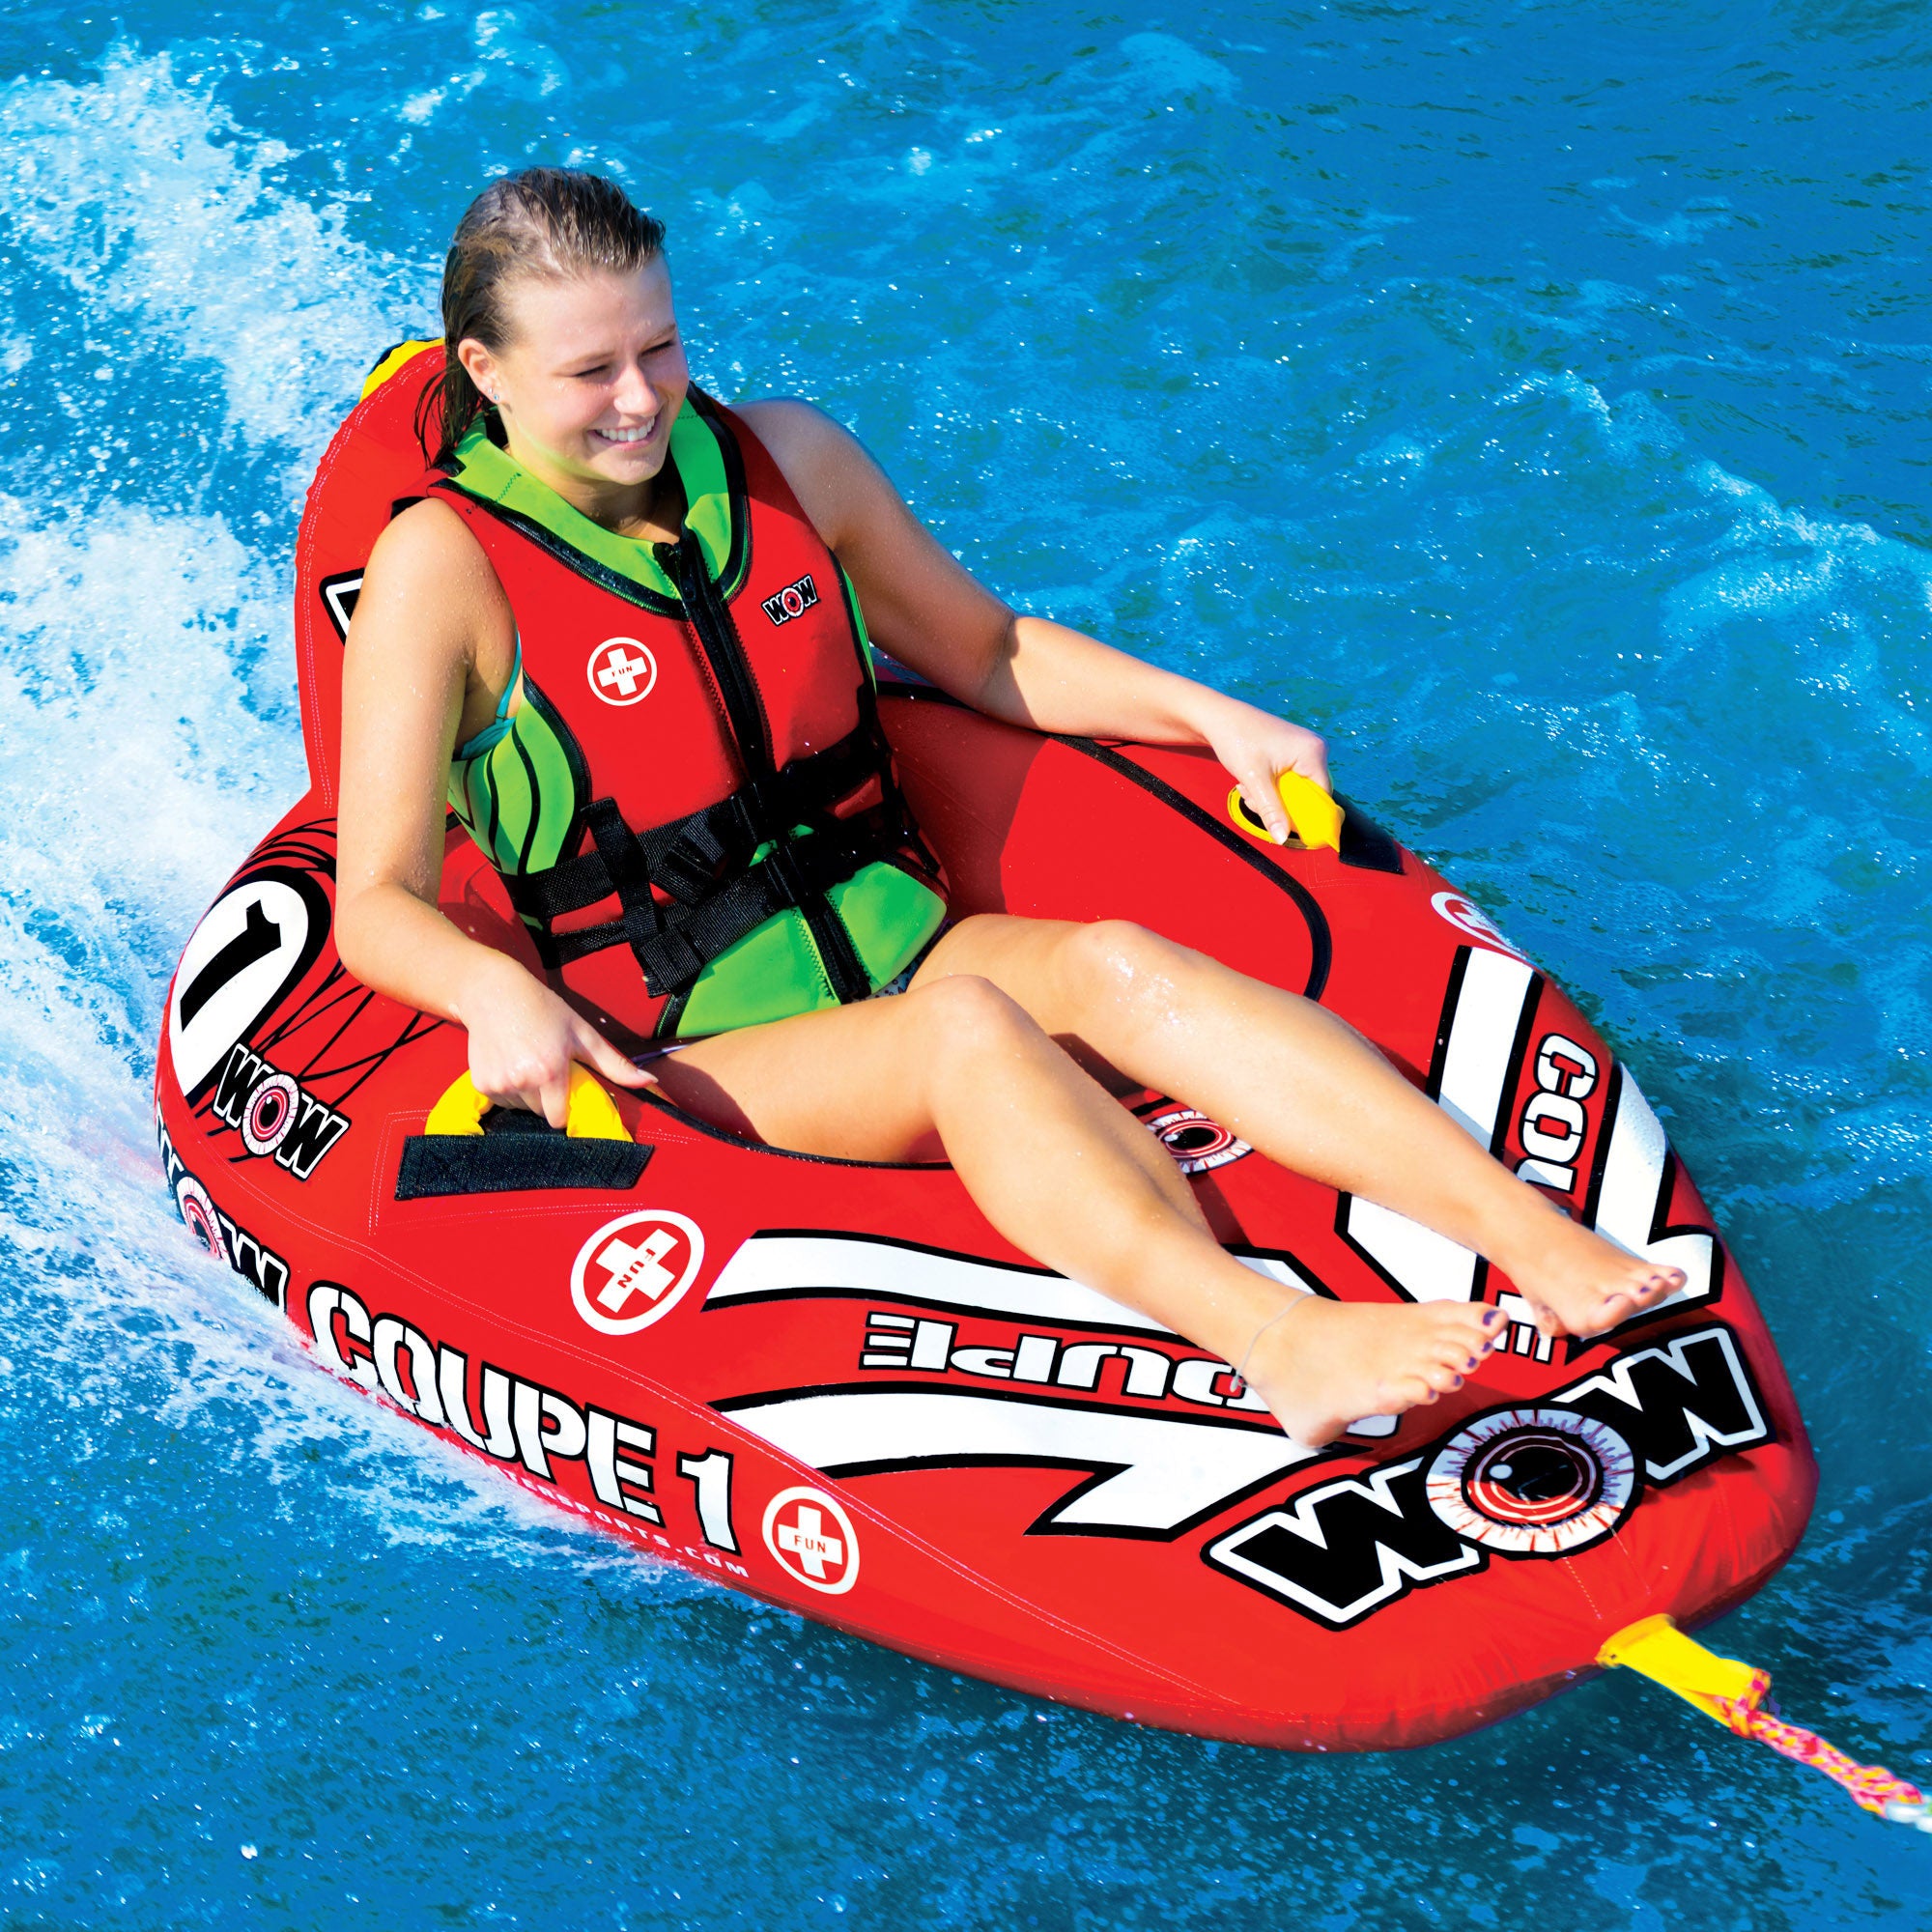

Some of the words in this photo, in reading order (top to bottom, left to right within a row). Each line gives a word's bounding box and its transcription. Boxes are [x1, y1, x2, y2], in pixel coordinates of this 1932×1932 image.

[762, 575, 819, 627] WOW
[611, 665, 633, 677] FUN
[213, 1042, 352, 1181] WOW
[616, 1247, 657, 1289] FUN
[306, 1280, 667, 1528] COUPE
[678, 1447, 742, 1556] 1
[1204, 1323, 1772, 1630] WOW
[793, 1534, 827, 1553] FUN
